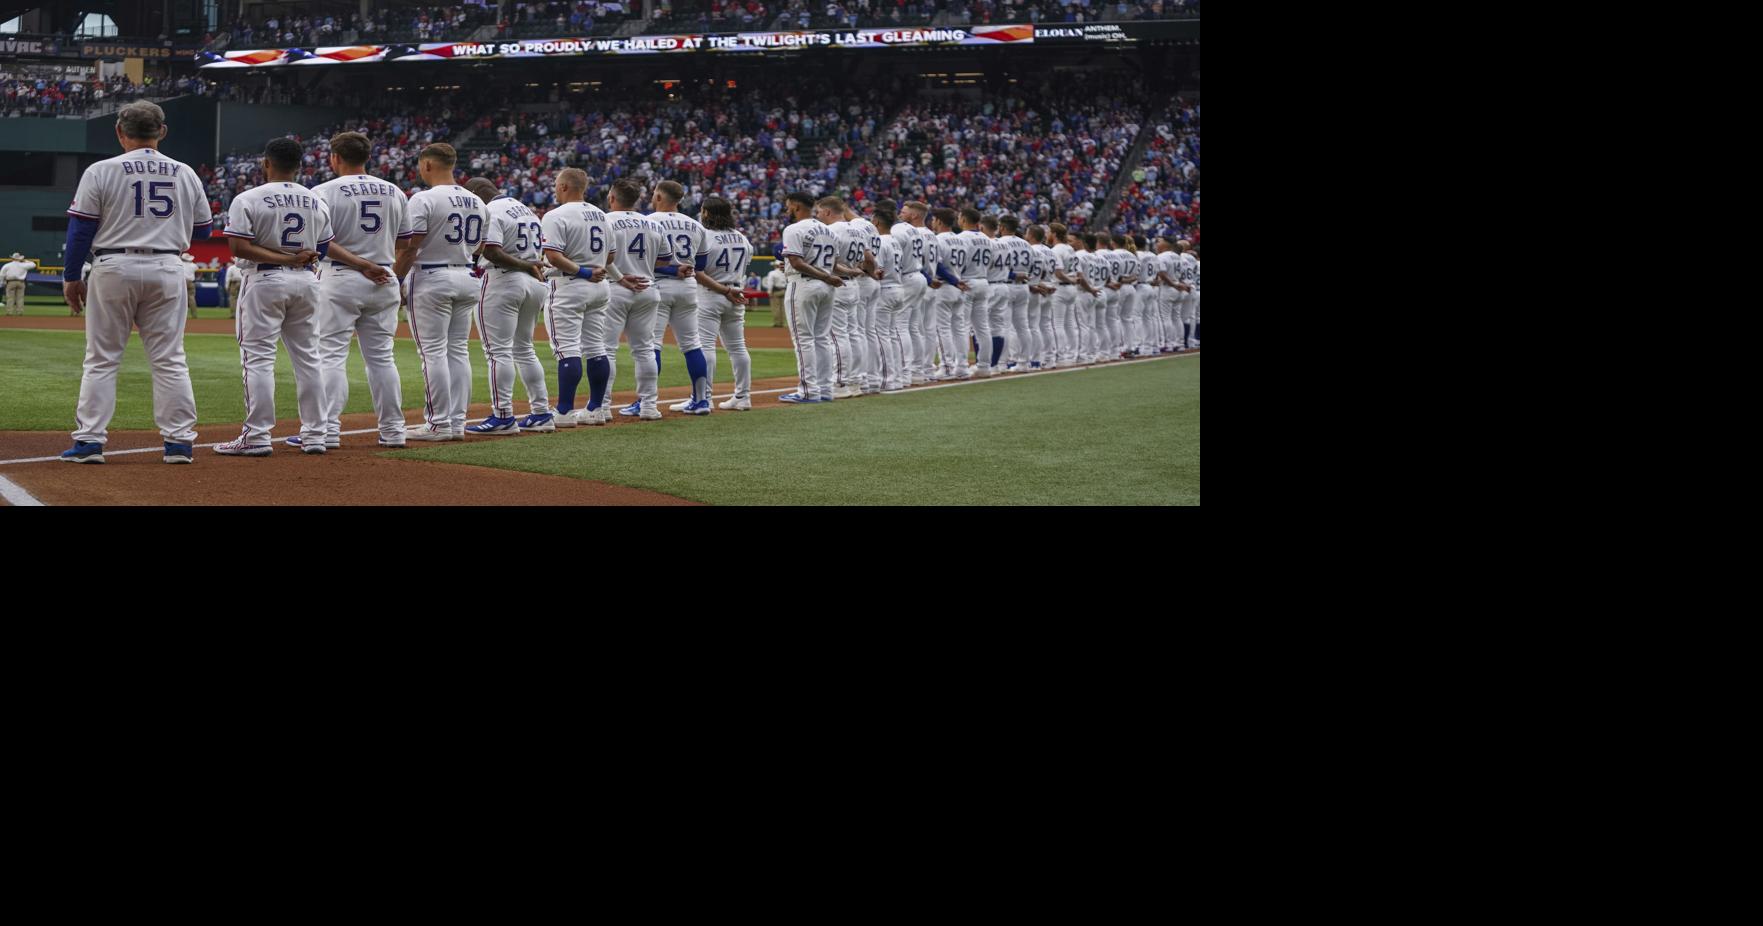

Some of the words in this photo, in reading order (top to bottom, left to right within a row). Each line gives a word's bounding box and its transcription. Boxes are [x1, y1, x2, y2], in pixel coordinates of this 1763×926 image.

[452, 44, 495, 56] WHAT
[500, 43, 519, 54] SO
[524, 41, 591, 54] PROUDLY
[596, 40, 621, 51] WE
[624, 39, 678, 50] HAILED
[683, 37, 704, 49] AT
[708, 36, 738, 48] THE
[742, 34, 831, 47] TWILIGHT'S
[835, 33, 874, 44] LAST
[881, 30, 965, 43] GLEAMING
[1034, 28, 1084, 38] ELOUAN
[83, 45, 171, 57] PLUCKERS
[122, 160, 181, 178] BOCHY
[130, 180, 177, 219] 15
[263, 193, 319, 210] SEMIEN
[340, 181, 396, 201] SEAGER
[448, 196, 479, 210] LOWE
[360, 200, 383, 235] 5
[581, 211, 605, 222] JUNG
[280, 212, 306, 250] 2
[444, 212, 483, 246] 30
[516, 222, 542, 251] 53
[589, 225, 604, 254] 6
[715, 234, 743, 245] SMITH
[628, 232, 646, 260] 4
[810, 244, 834, 268] 72
[846, 241, 867, 264] 66
[949, 248, 966, 267] 50
[971, 248, 991, 267] 46
[715, 247, 745, 272] 47
